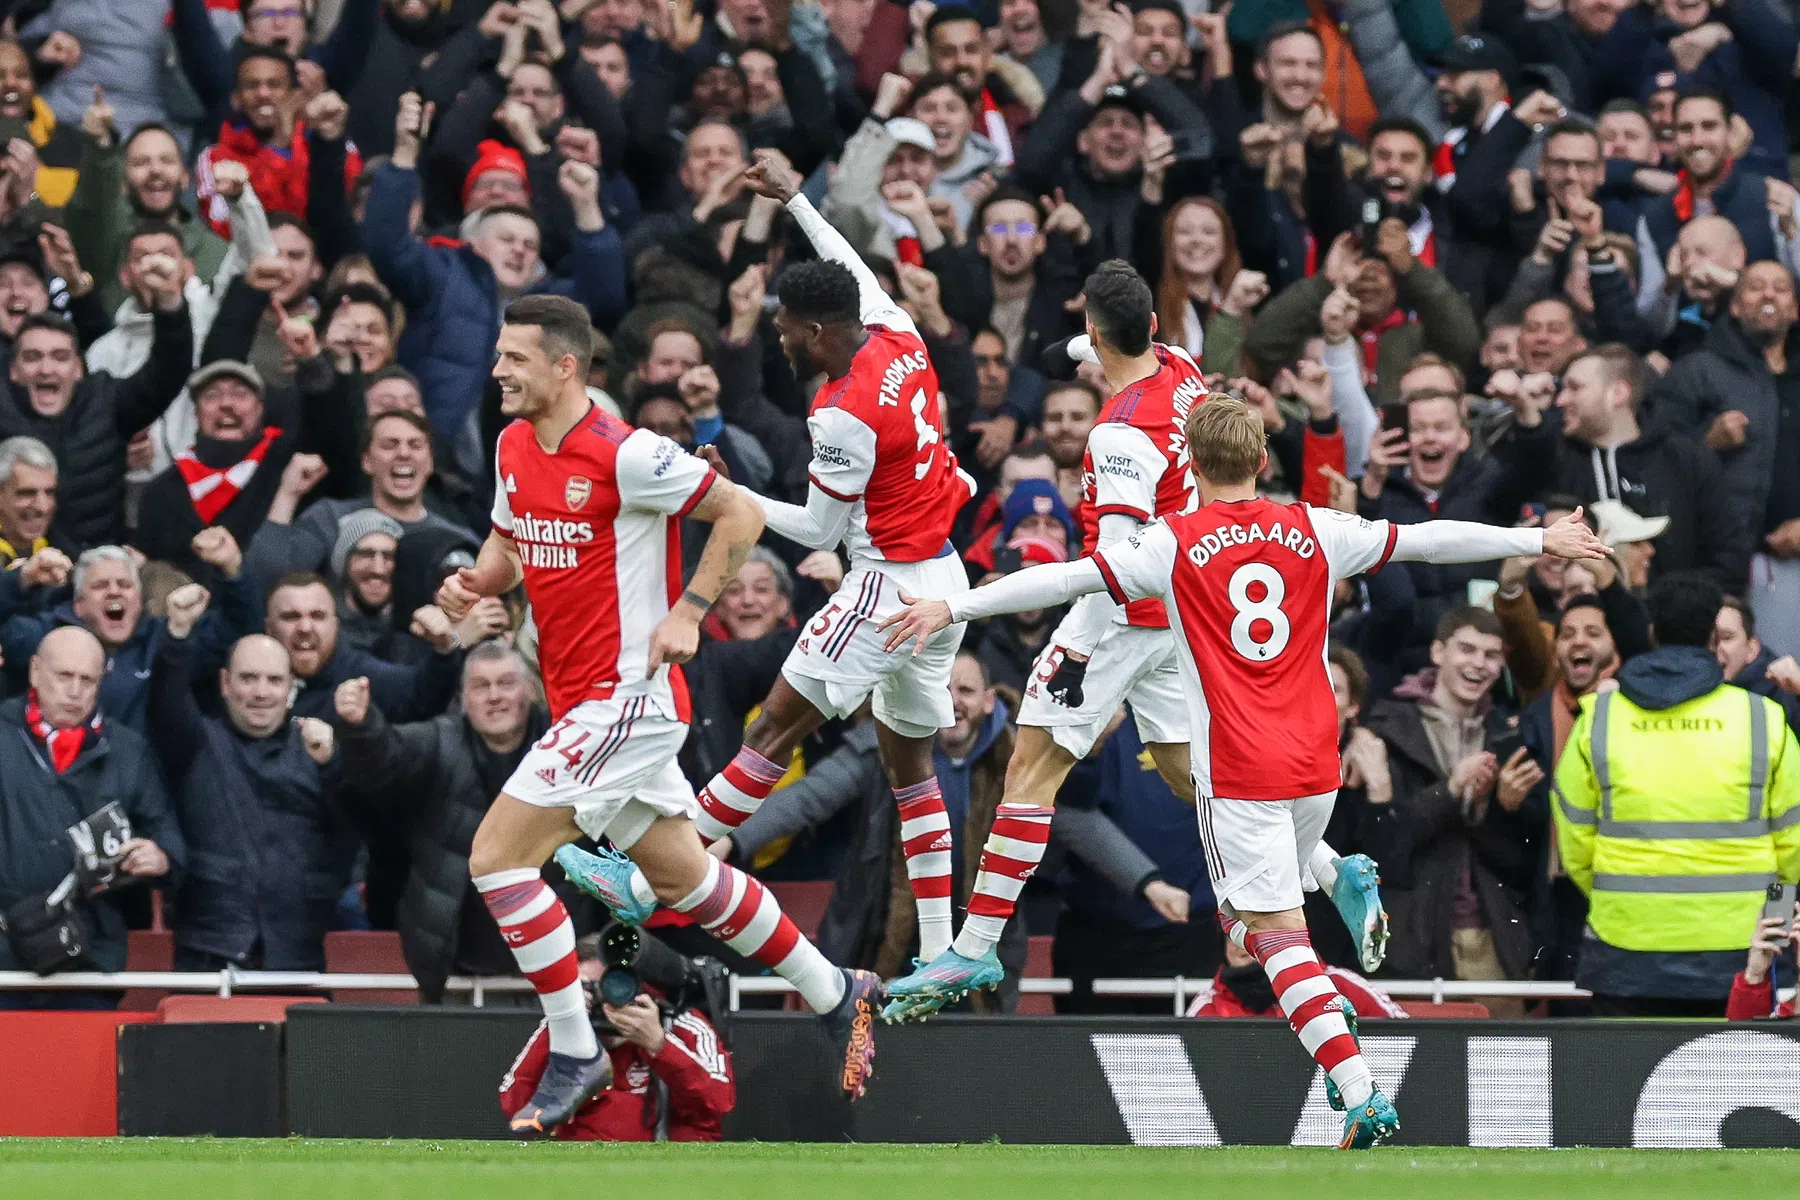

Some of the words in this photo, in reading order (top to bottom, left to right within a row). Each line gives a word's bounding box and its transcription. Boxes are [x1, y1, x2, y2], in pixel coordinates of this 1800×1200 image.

[878, 350, 928, 407] THOMAS
[1167, 375, 1210, 455] MARTINEL
[818, 443, 842, 456] VISIT
[1106, 455, 1132, 467] VISIT
[512, 511, 594, 545] mirates
[1188, 522, 1316, 567] ØDEGAARD
[532, 544, 578, 568] BETTER
[810, 603, 842, 636] 5
[1228, 562, 1291, 662] 8
[1032, 645, 1067, 683] 5
[1631, 718, 1725, 732] SECURITY
[537, 718, 591, 772] 34
